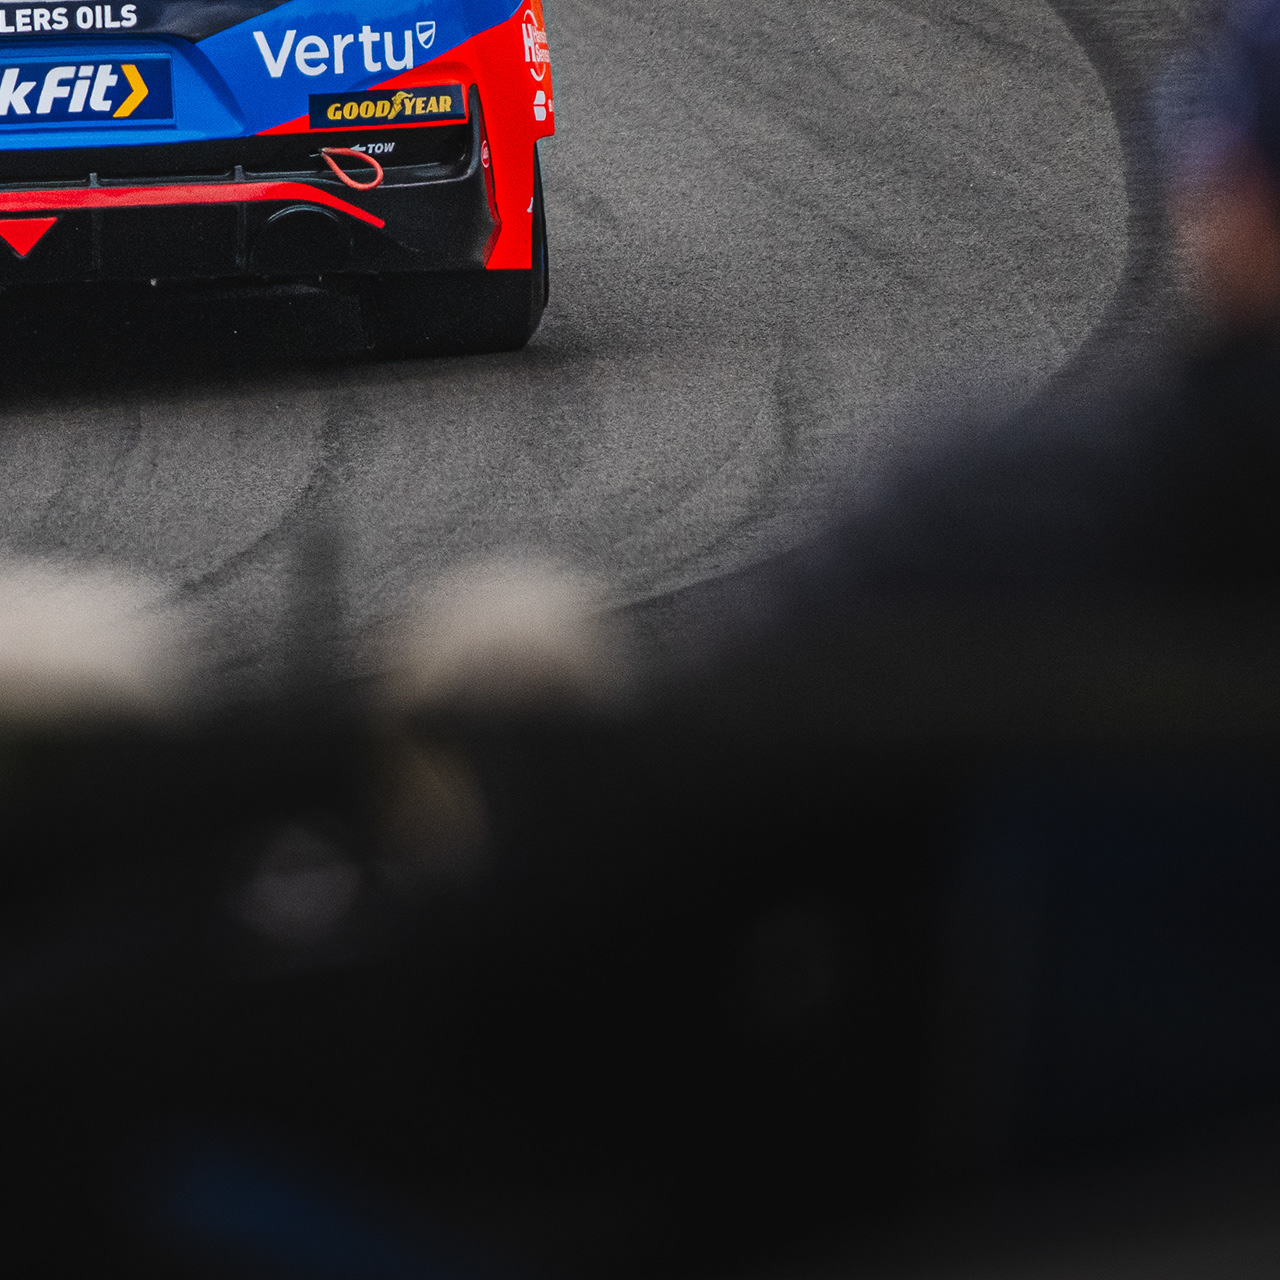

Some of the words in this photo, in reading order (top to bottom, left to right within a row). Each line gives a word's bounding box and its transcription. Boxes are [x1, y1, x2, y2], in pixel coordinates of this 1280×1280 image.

[76, 4, 138, 29] OILS
[253, 25, 415, 78] Vertu
[367, 142, 395, 154] TOW
